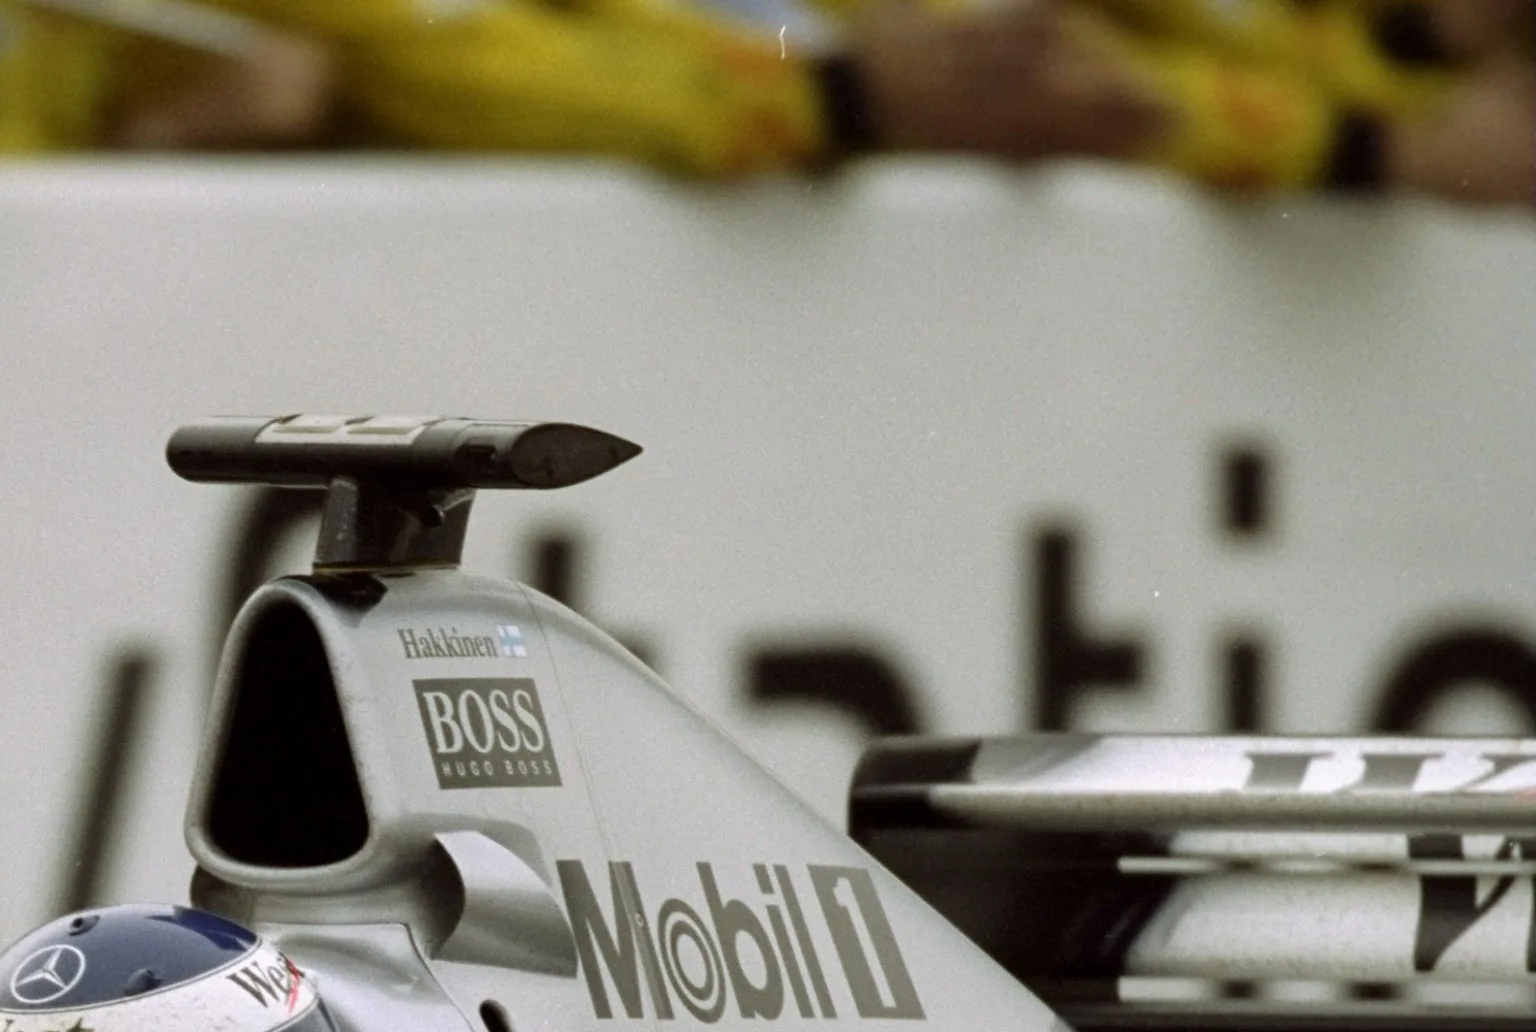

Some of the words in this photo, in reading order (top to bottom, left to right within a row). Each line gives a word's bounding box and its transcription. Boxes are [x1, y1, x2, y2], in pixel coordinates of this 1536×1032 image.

[397, 626, 499, 659] Hakkinen
[422, 689, 545, 753] BOSS
[441, 760, 494, 776] HUGO
[503, 759, 554, 775] BOSS
[557, 860, 837, 1024] Mobil
